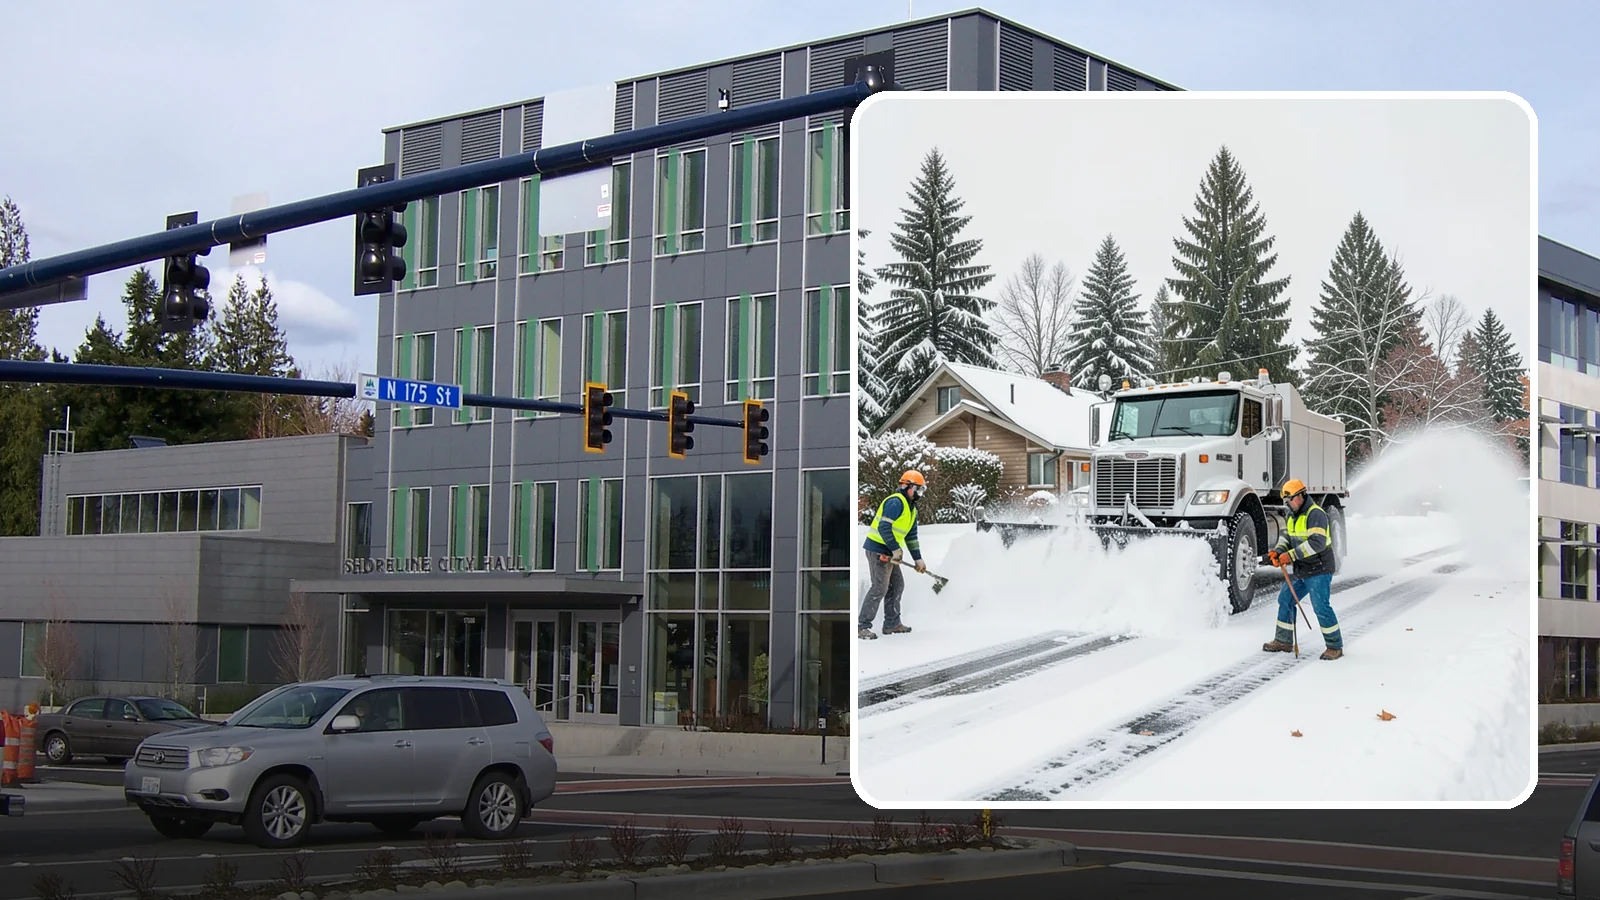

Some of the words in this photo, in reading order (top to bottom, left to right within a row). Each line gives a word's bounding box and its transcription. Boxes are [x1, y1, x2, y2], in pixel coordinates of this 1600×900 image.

[387, 380, 396, 400] N
[405, 382, 427, 403] 175
[436, 386, 451, 406] St
[343, 557, 432, 573] SHORELINE
[438, 556, 475, 572] CITY
[483, 556, 526, 571] HALL
